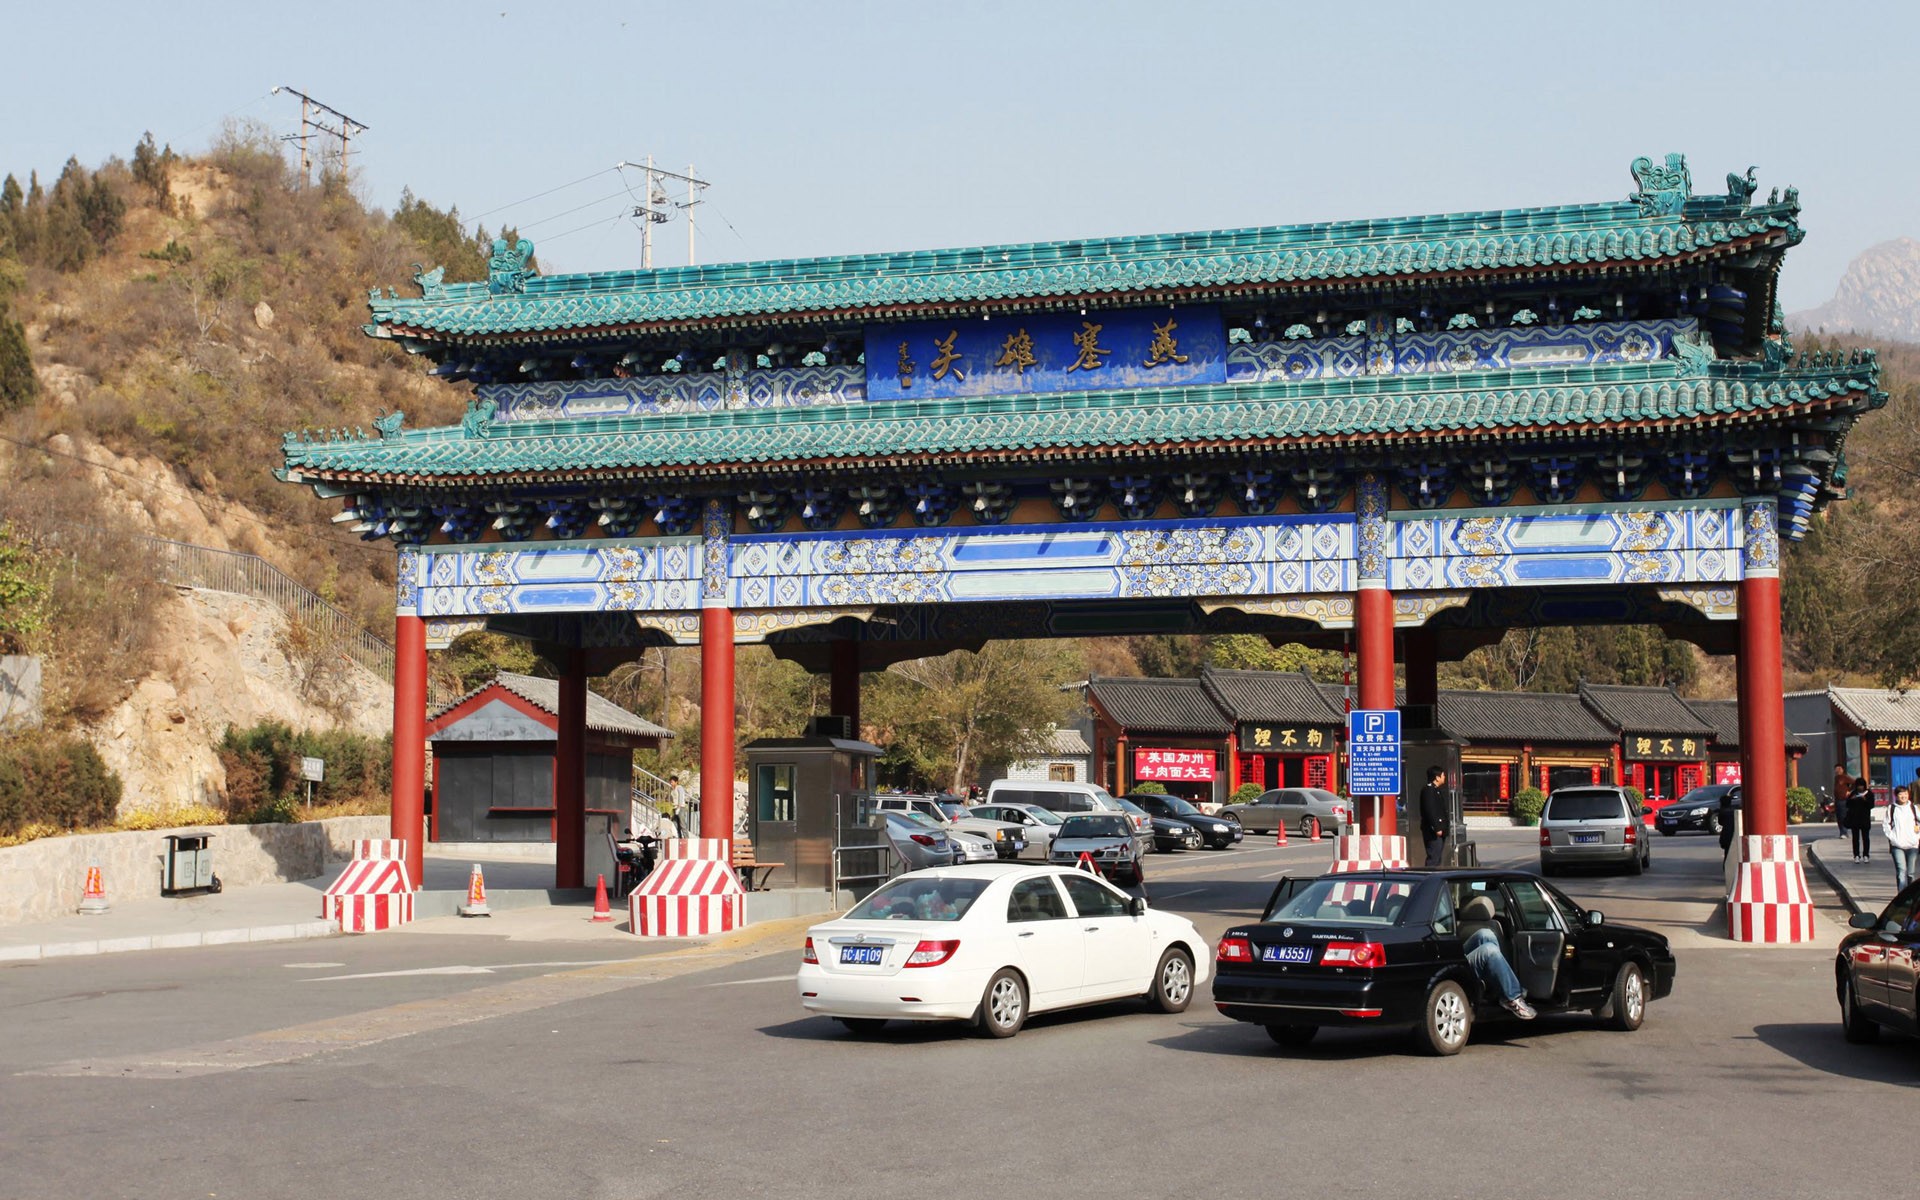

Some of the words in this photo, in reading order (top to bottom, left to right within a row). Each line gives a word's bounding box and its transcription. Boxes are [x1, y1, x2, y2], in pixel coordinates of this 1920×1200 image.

[1368, 716, 1382, 731] P
[1356, 734, 1394, 742] 收费停车
[1146, 752, 1205, 764] 美国加州
[1139, 765, 1212, 779] 牛肉面大王
[1725, 765, 1741, 776] 美
